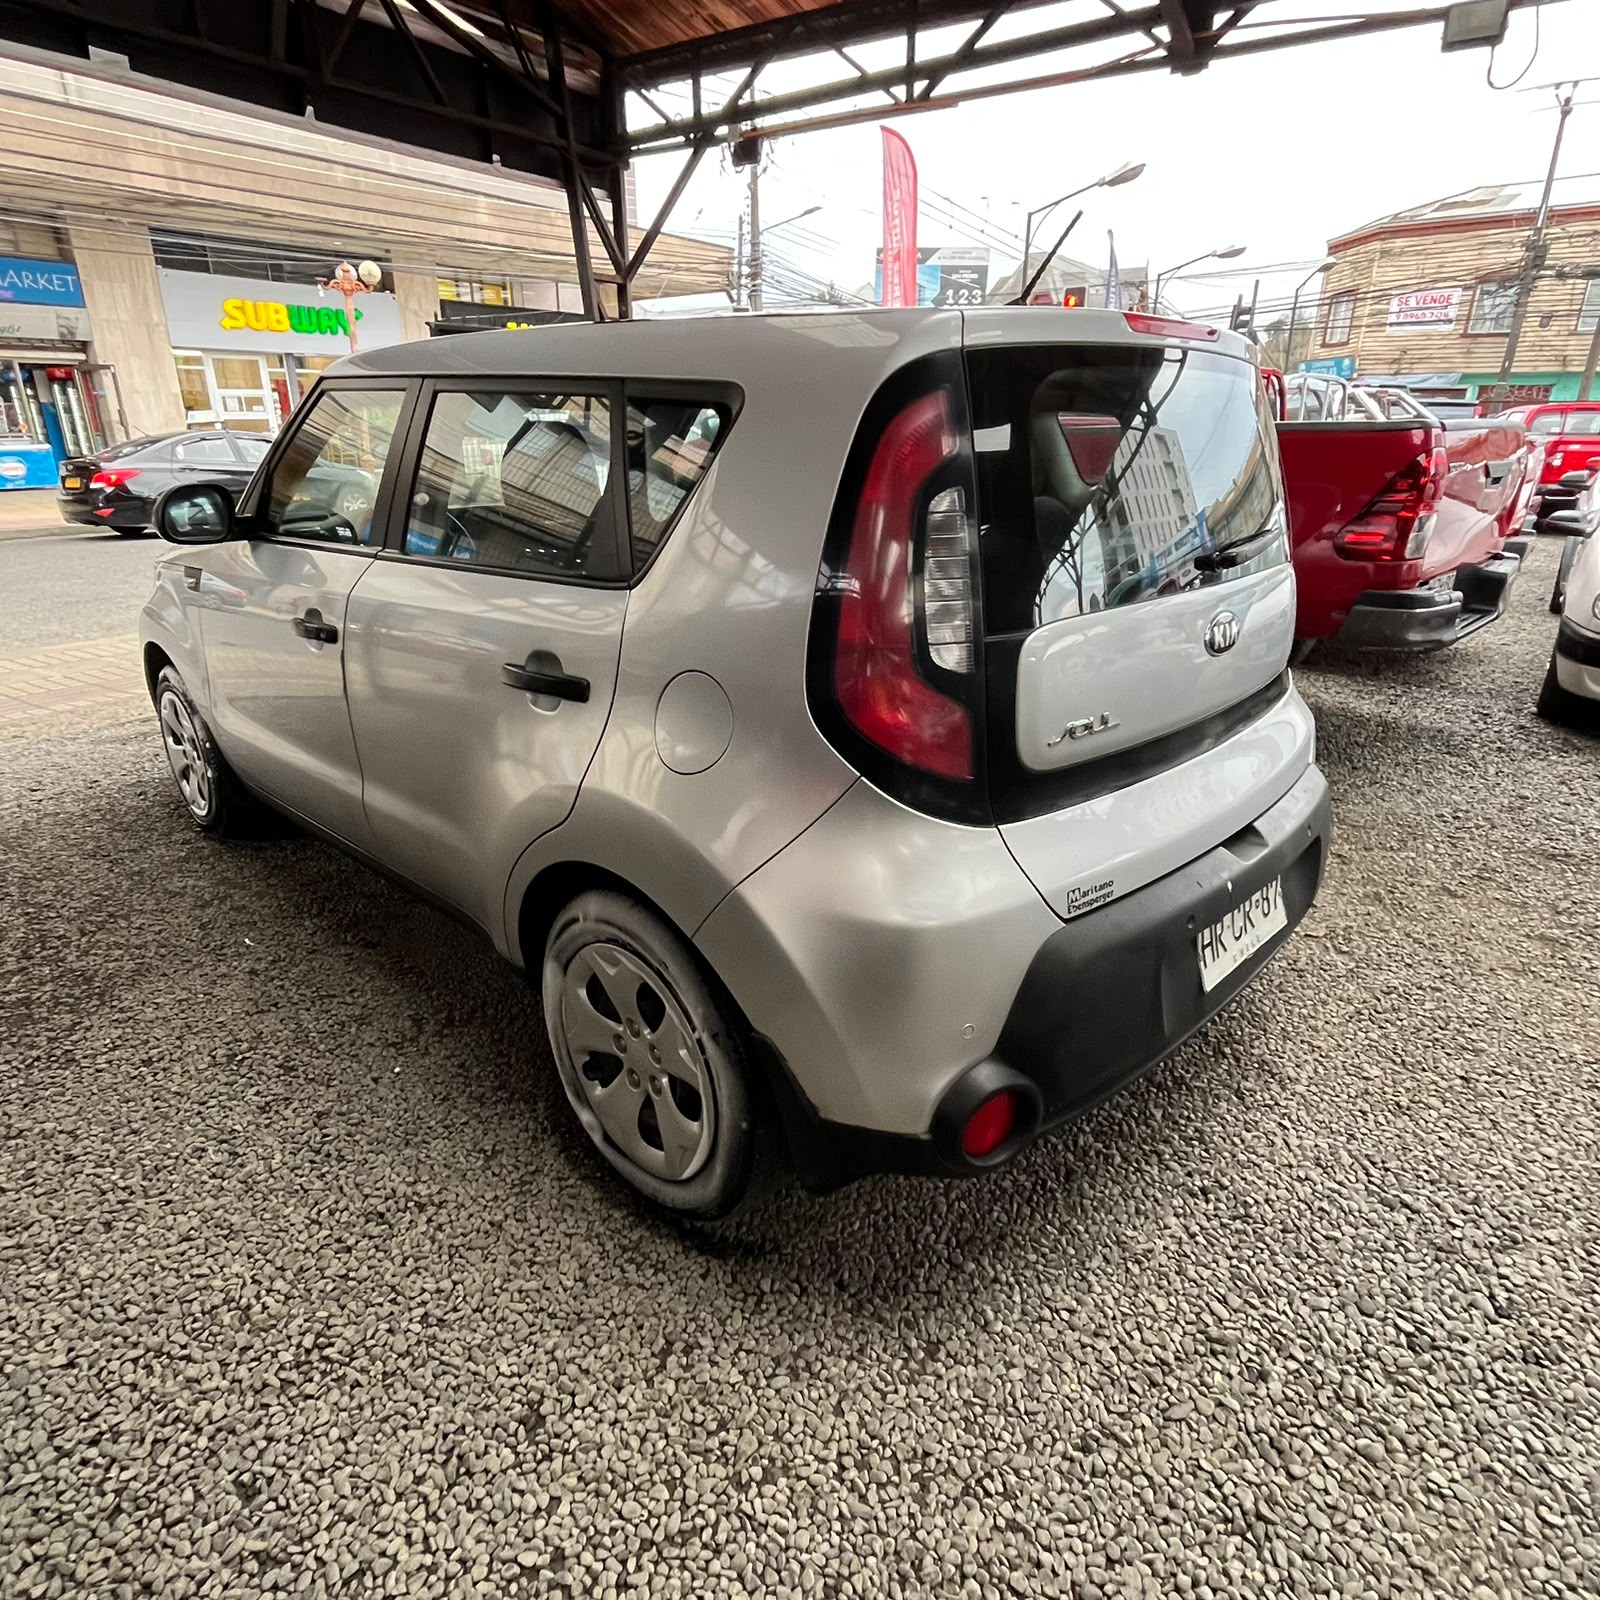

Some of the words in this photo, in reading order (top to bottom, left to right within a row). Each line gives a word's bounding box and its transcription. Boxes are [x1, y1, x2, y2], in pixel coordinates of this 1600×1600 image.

[0, 269, 77, 293] ARKET
[1397, 295, 1412, 307] SE
[1415, 294, 1454, 306] VENDE
[219, 298, 363, 336] SUBWAY
[1048, 712, 1120, 746] SOUL
[1067, 880, 1114, 904] Maritano
[1067, 890, 1114, 914] Ebensperger
